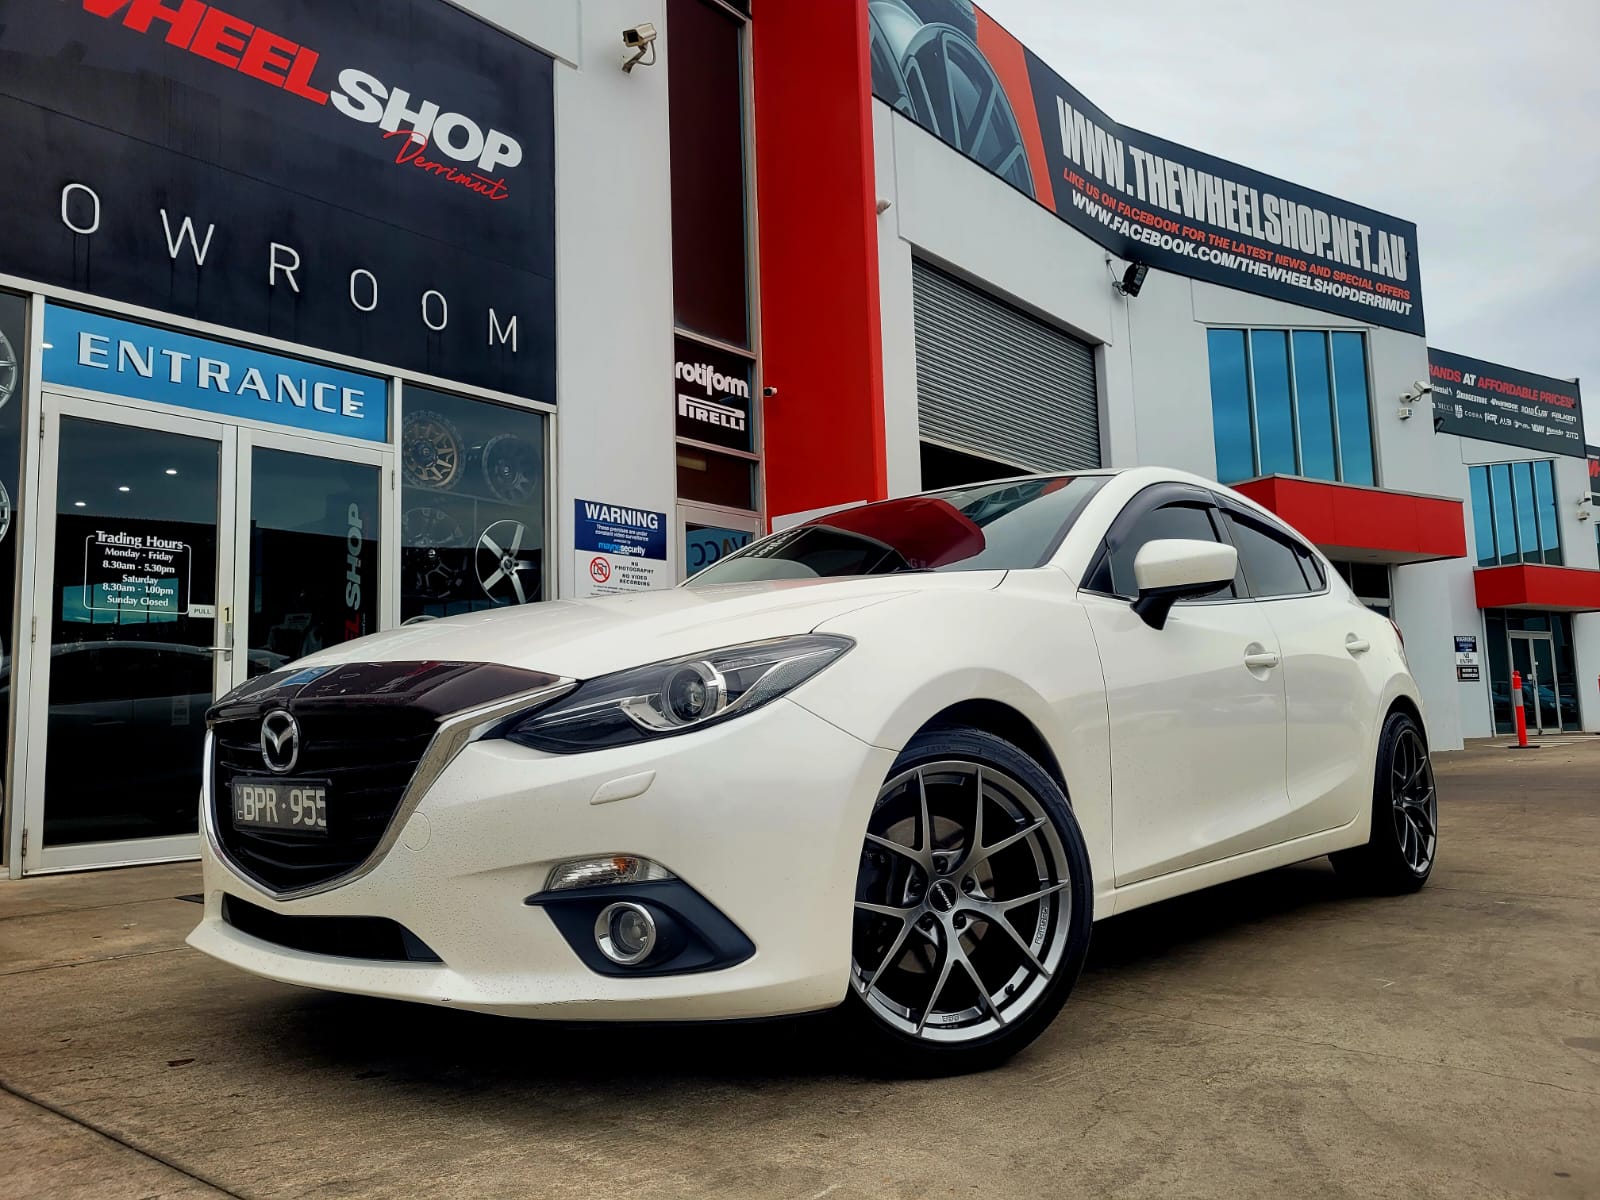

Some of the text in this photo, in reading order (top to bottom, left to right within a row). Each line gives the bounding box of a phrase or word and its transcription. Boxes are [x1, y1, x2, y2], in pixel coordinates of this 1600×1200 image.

[383, 130, 509, 200] Derrimut
[1063, 167, 1411, 300] LIKE US ON FACEBOOK FOR THE LATEST NEWS AND SPECIAL OFFERS
[78, 331, 365, 418] ENTRANCE
[675, 361, 749, 398] rotiform
[1462, 372, 1476, 386] AT
[1477, 376, 1539, 401] AFFORDABLE
[678, 393, 746, 431] PIRELLI
[584, 502, 658, 530] WARNING
[95, 530, 183, 550] Trading Hours
[102, 560, 135, 570] 8.30am
[144, 563, 175, 575] 5.30pm
[104, 547, 140, 560] Monday
[148, 551, 173, 563] Friday
[102, 583, 135, 592] 8.30am
[145, 585, 174, 597] 1.00pm
[122, 574, 158, 586] Saturday
[107, 595, 169, 607] Sunday Closed
